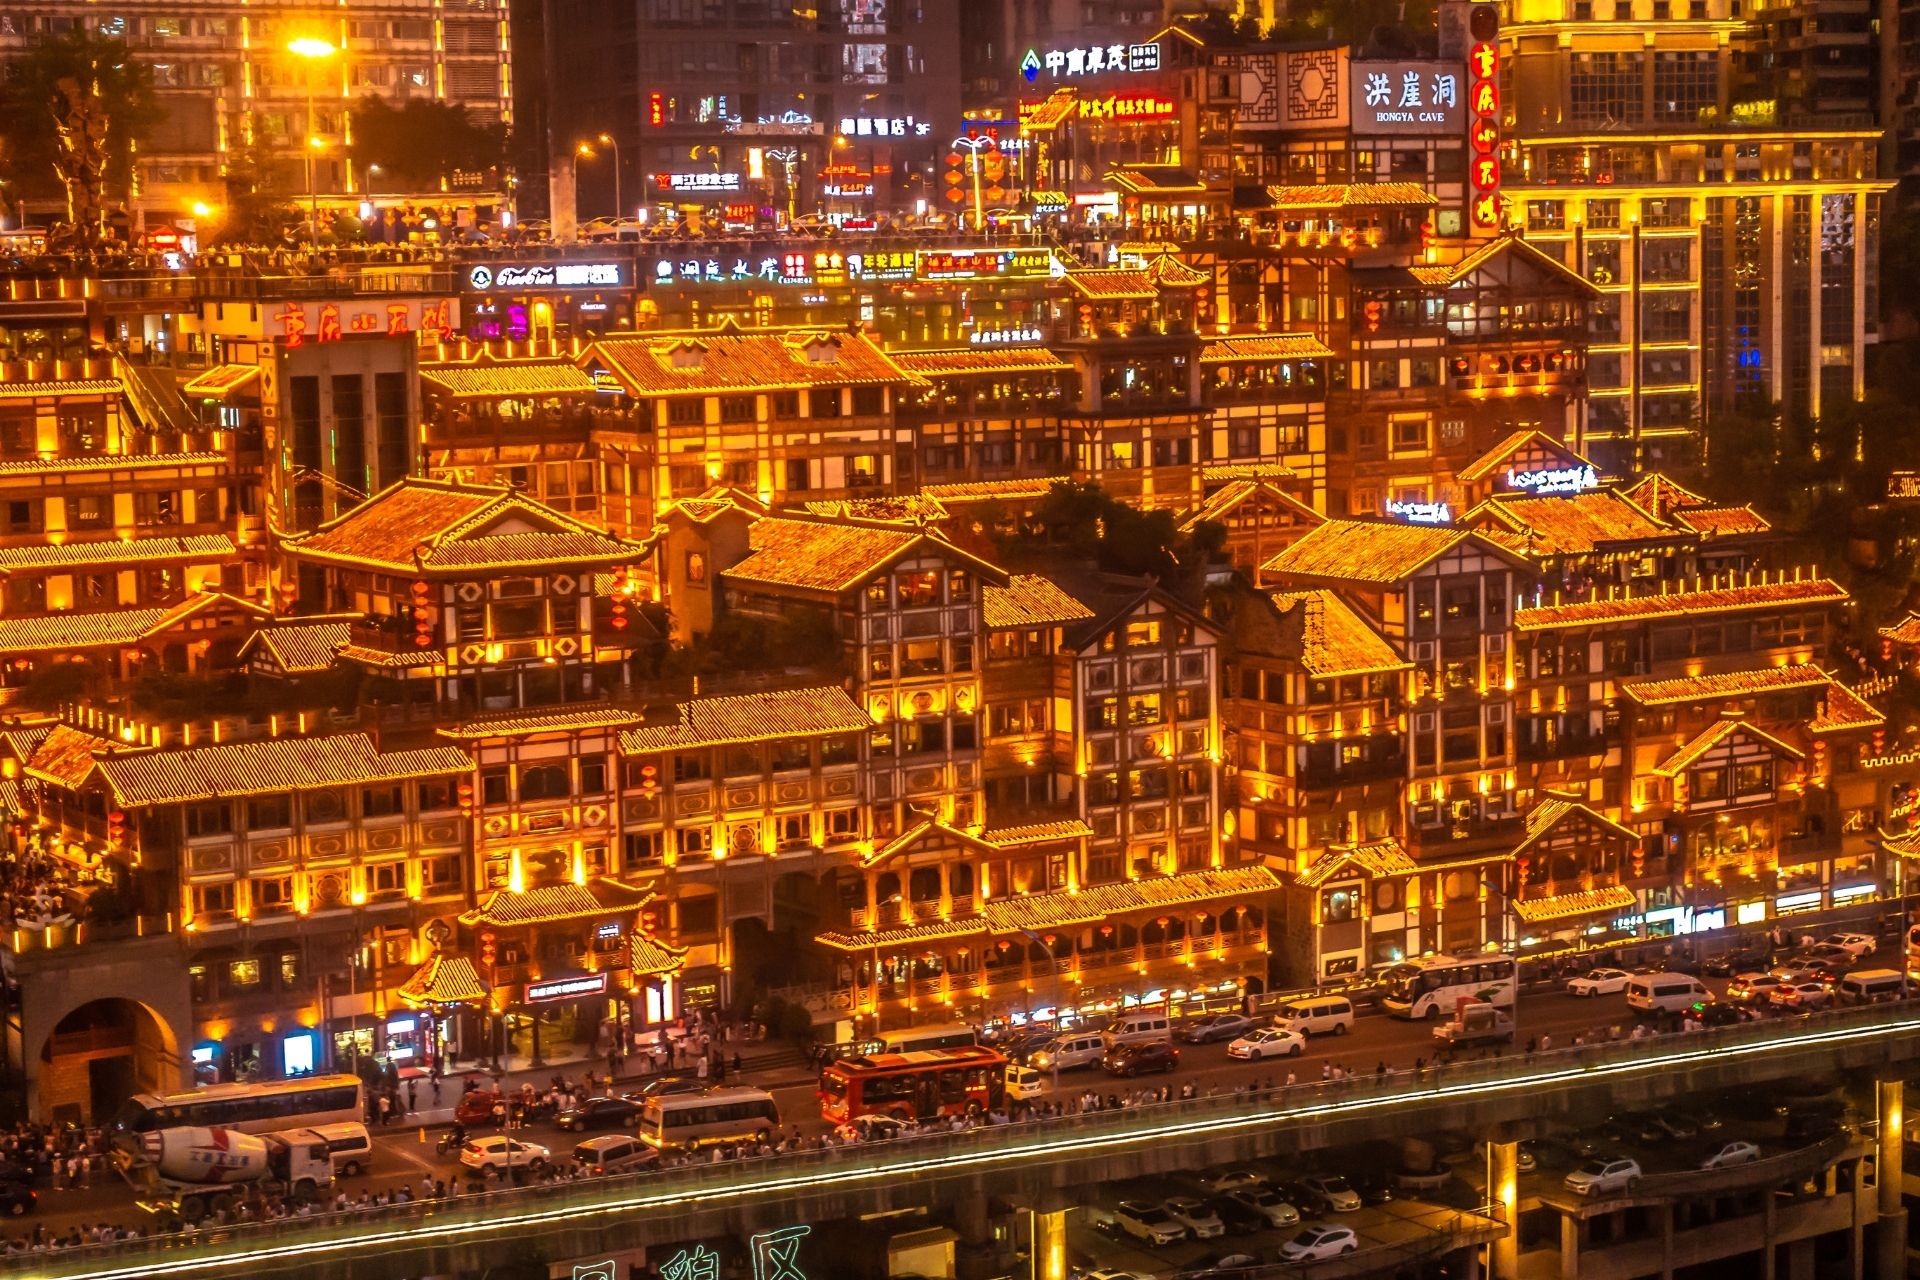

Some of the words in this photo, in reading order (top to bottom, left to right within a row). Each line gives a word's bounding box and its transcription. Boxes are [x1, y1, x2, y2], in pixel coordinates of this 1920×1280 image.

[1363, 71, 1456, 108] 洪崖洞
[1376, 112, 1414, 122] HONGYA
[1419, 112, 1444, 122] CAVE
[1475, 44, 1497, 223] 重庆小天鹅
[274, 300, 452, 348] 重庆小天鹅
